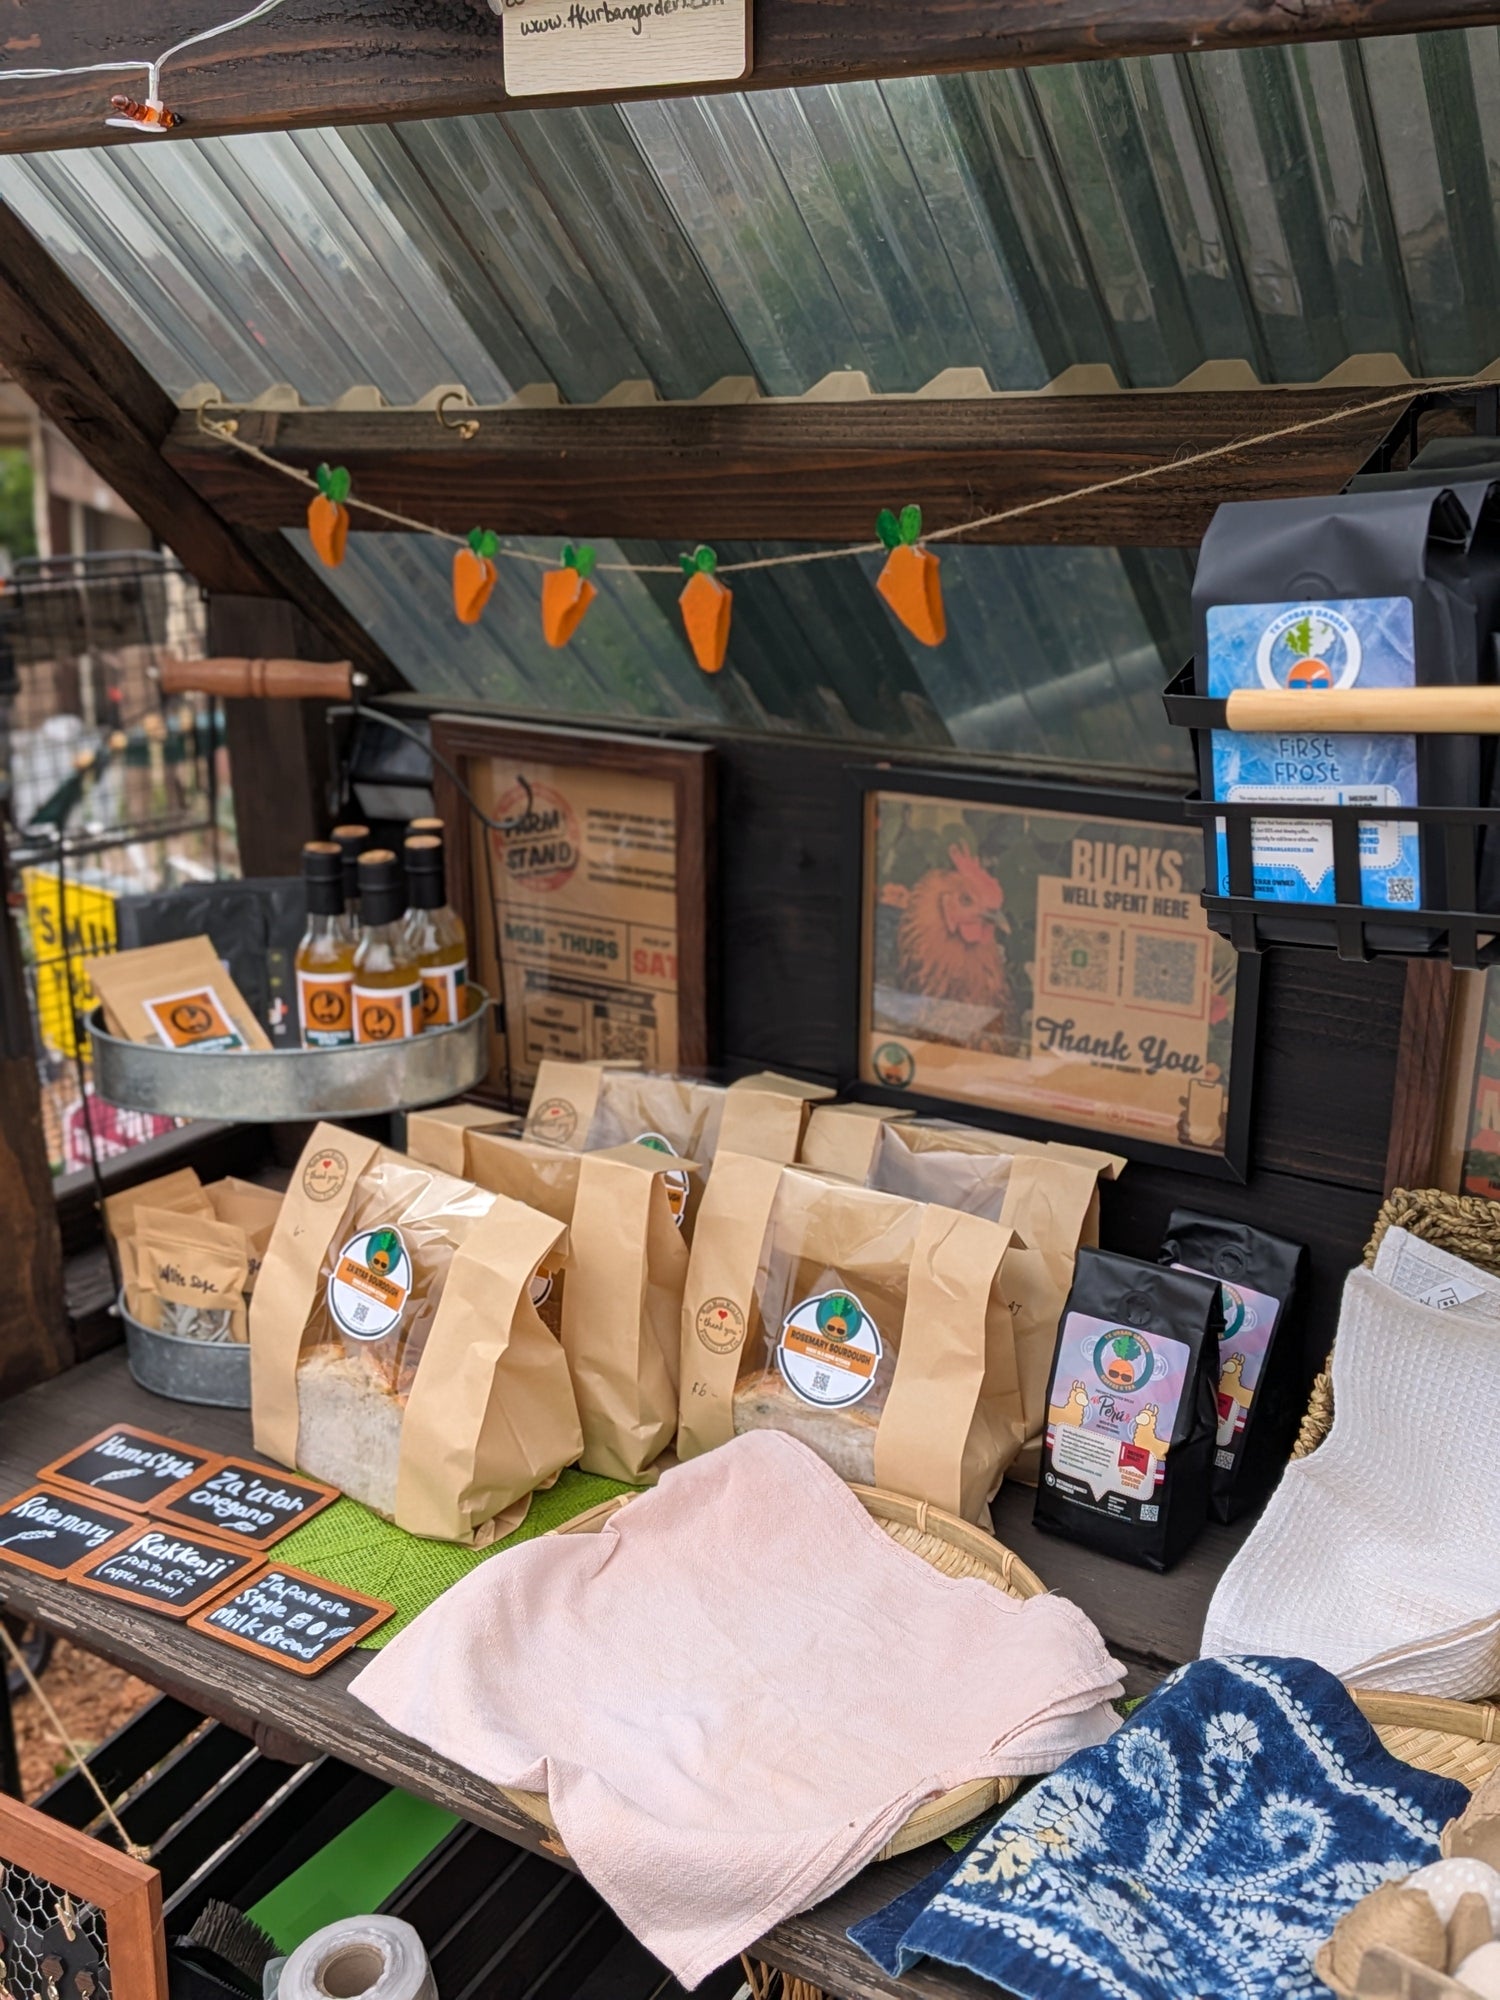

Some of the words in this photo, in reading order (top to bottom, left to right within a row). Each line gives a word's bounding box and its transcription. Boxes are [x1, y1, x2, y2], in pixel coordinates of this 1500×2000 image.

[507, 842, 572, 871] STAND
[1071, 838, 1184, 894] BUCKS
[1062, 885, 1100, 909] WELL
[1103, 891, 1149, 916] SPENT
[1152, 897, 1190, 920] HERE
[505, 923, 545, 945] MON
[559, 931, 619, 960] THURS
[1036, 1016, 1132, 1062] Thank
[1138, 1036, 1204, 1076] You
[790, 1330, 829, 1349] ROSEMARY
[828, 1343, 872, 1365] SOURDOUGH
[1101, 1375, 1121, 1390] COFFEE
[1121, 1480, 1139, 1490] COFFEE
[11, 1496, 115, 1548] Rosemary
[235, 1588, 288, 1618] Style
[258, 1573, 351, 1618] Japanese
[209, 1607, 265, 1636] Milk
[256, 1625, 325, 1659] Bread
